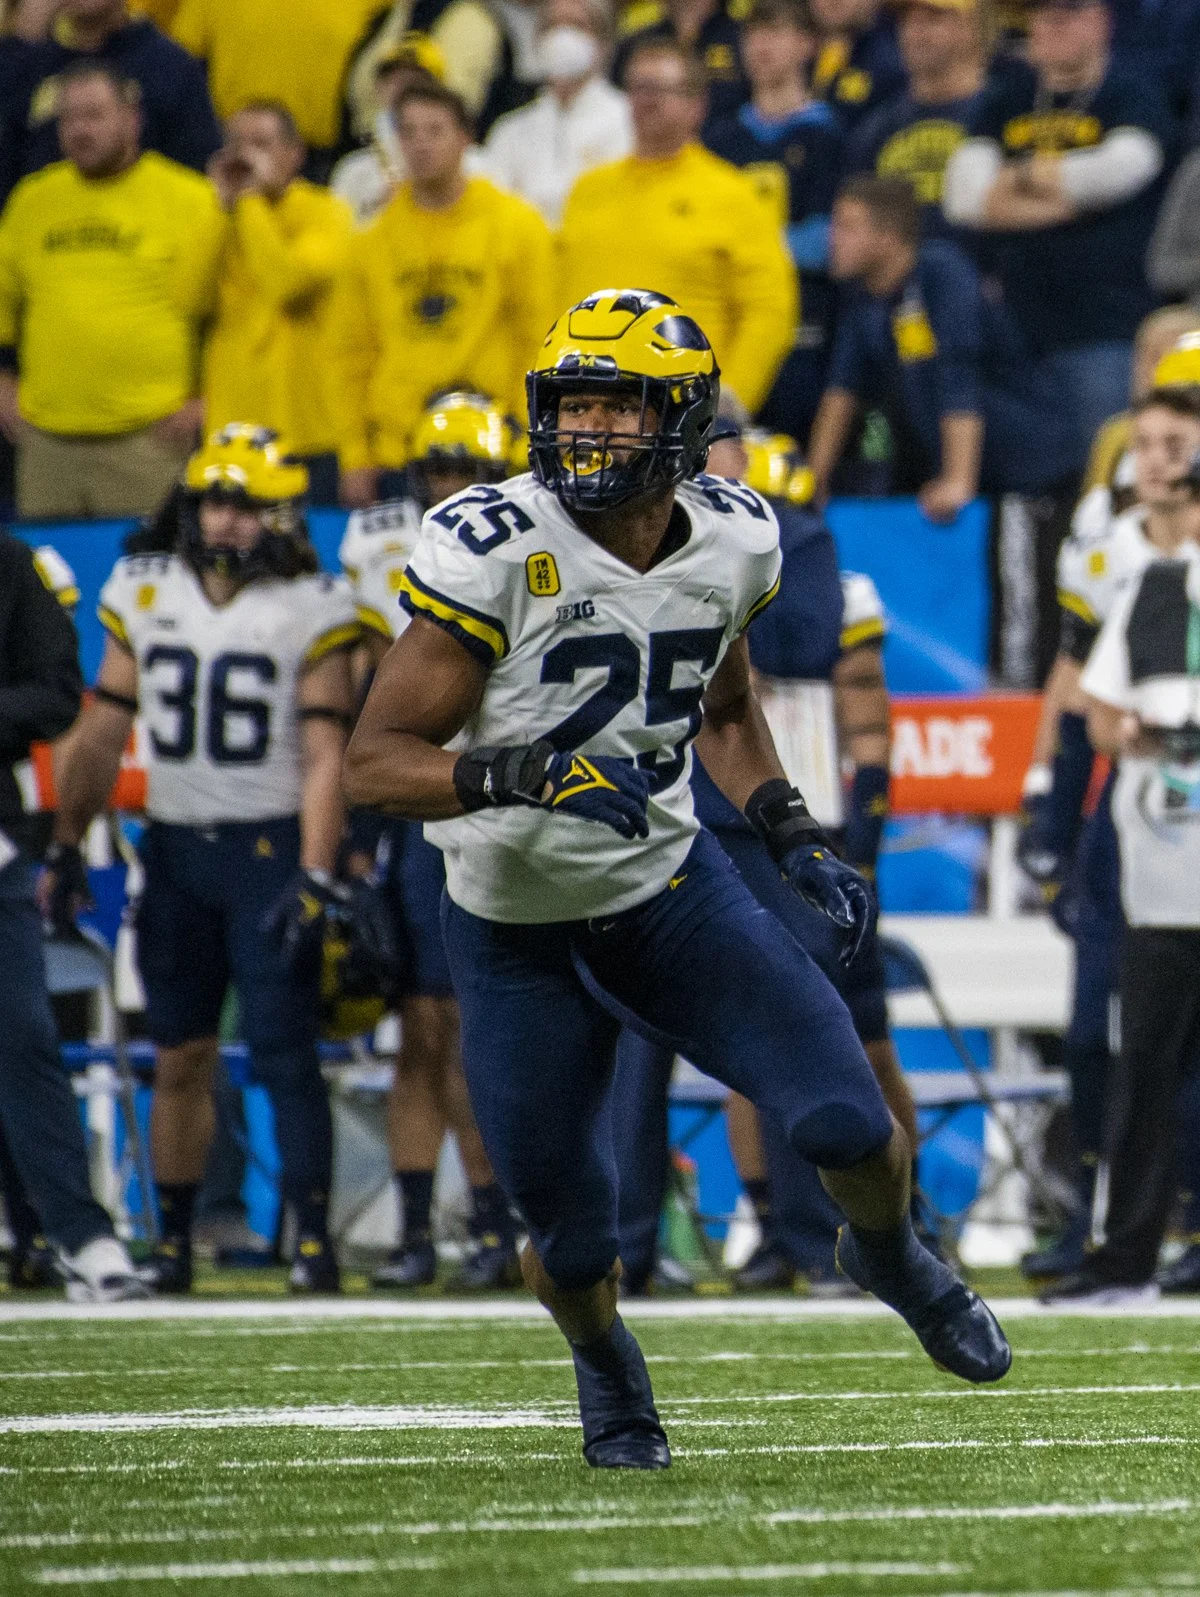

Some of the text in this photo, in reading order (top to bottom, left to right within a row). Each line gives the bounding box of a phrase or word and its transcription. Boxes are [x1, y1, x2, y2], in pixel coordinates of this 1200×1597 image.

[579, 355, 596, 367] M
[430, 486, 536, 556] 25
[145, 644, 278, 768] 36
[540, 627, 726, 793] 25
